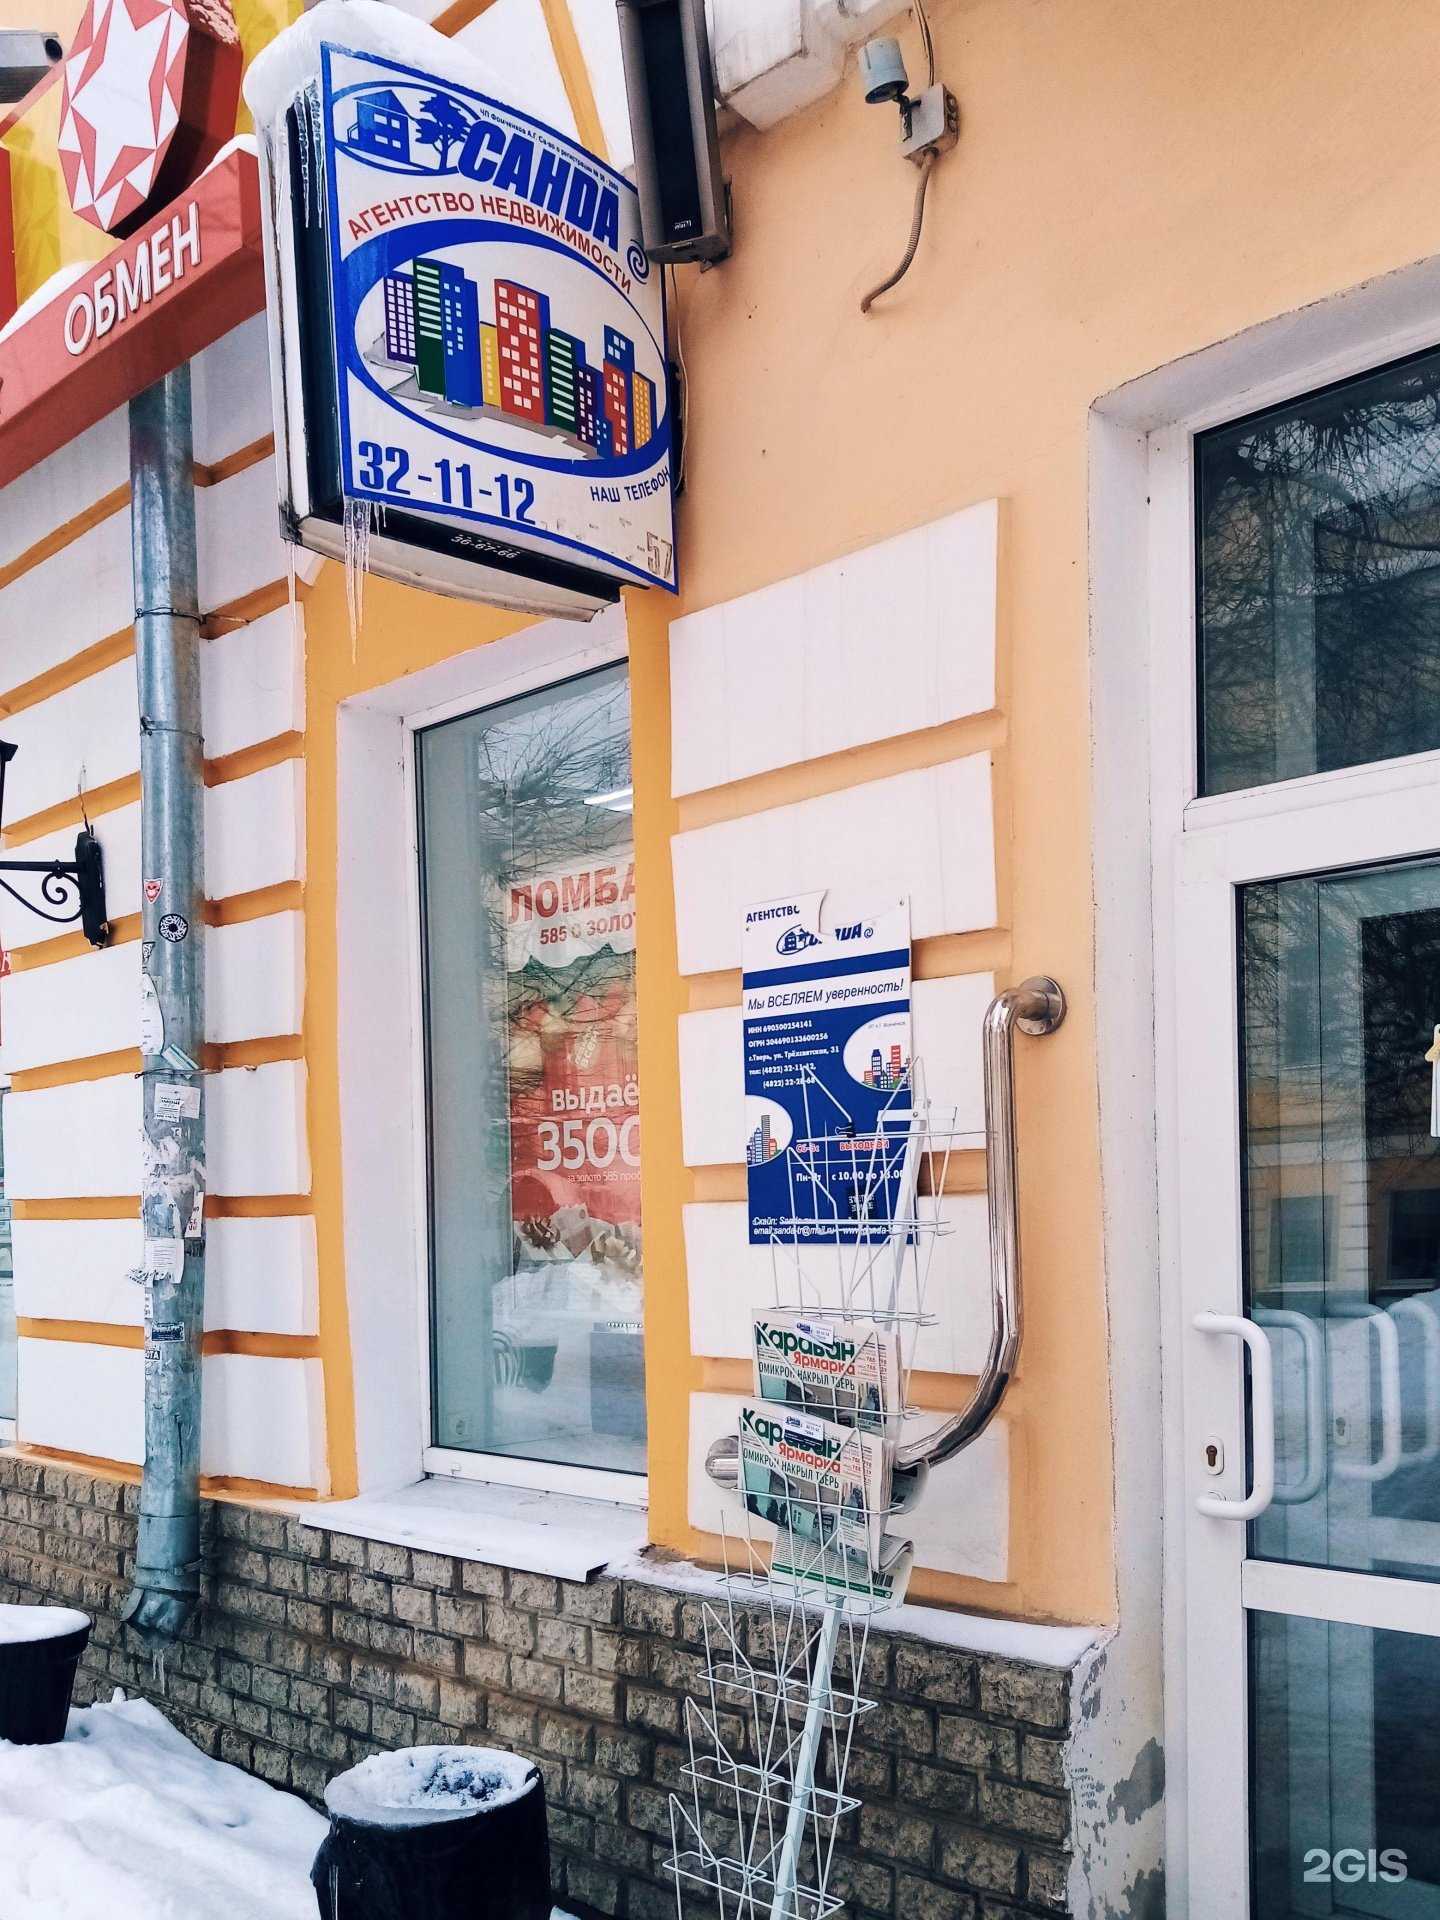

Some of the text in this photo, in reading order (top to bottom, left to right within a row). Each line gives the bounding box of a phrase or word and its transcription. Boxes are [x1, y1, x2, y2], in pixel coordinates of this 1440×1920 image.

[347, 192, 632, 294] АГЕНТСТВО НЕДВИЖИМОСТИ
[63, 201, 202, 357] ОБМЕН
[358, 440, 536, 525] 32-11-12
[590, 466, 671, 503] НАШ ТЕЛЕФОН
[540, 926, 567, 945] 585
[748, 978, 904, 1011] Мы ВСЕЛЯЕМ уверенность!
[748, 1026, 762, 1034] ИНН
[748, 1039, 765, 1048] ОГРН
[830, 1045, 839, 1053] 31
[793, 1351, 856, 1376] Ярмарка
[797, 1370, 829, 1386] НАКРЫЛ
[778, 1442, 841, 1474] Ярмарка
[781, 1462, 813, 1481] НАКРЫЛ
